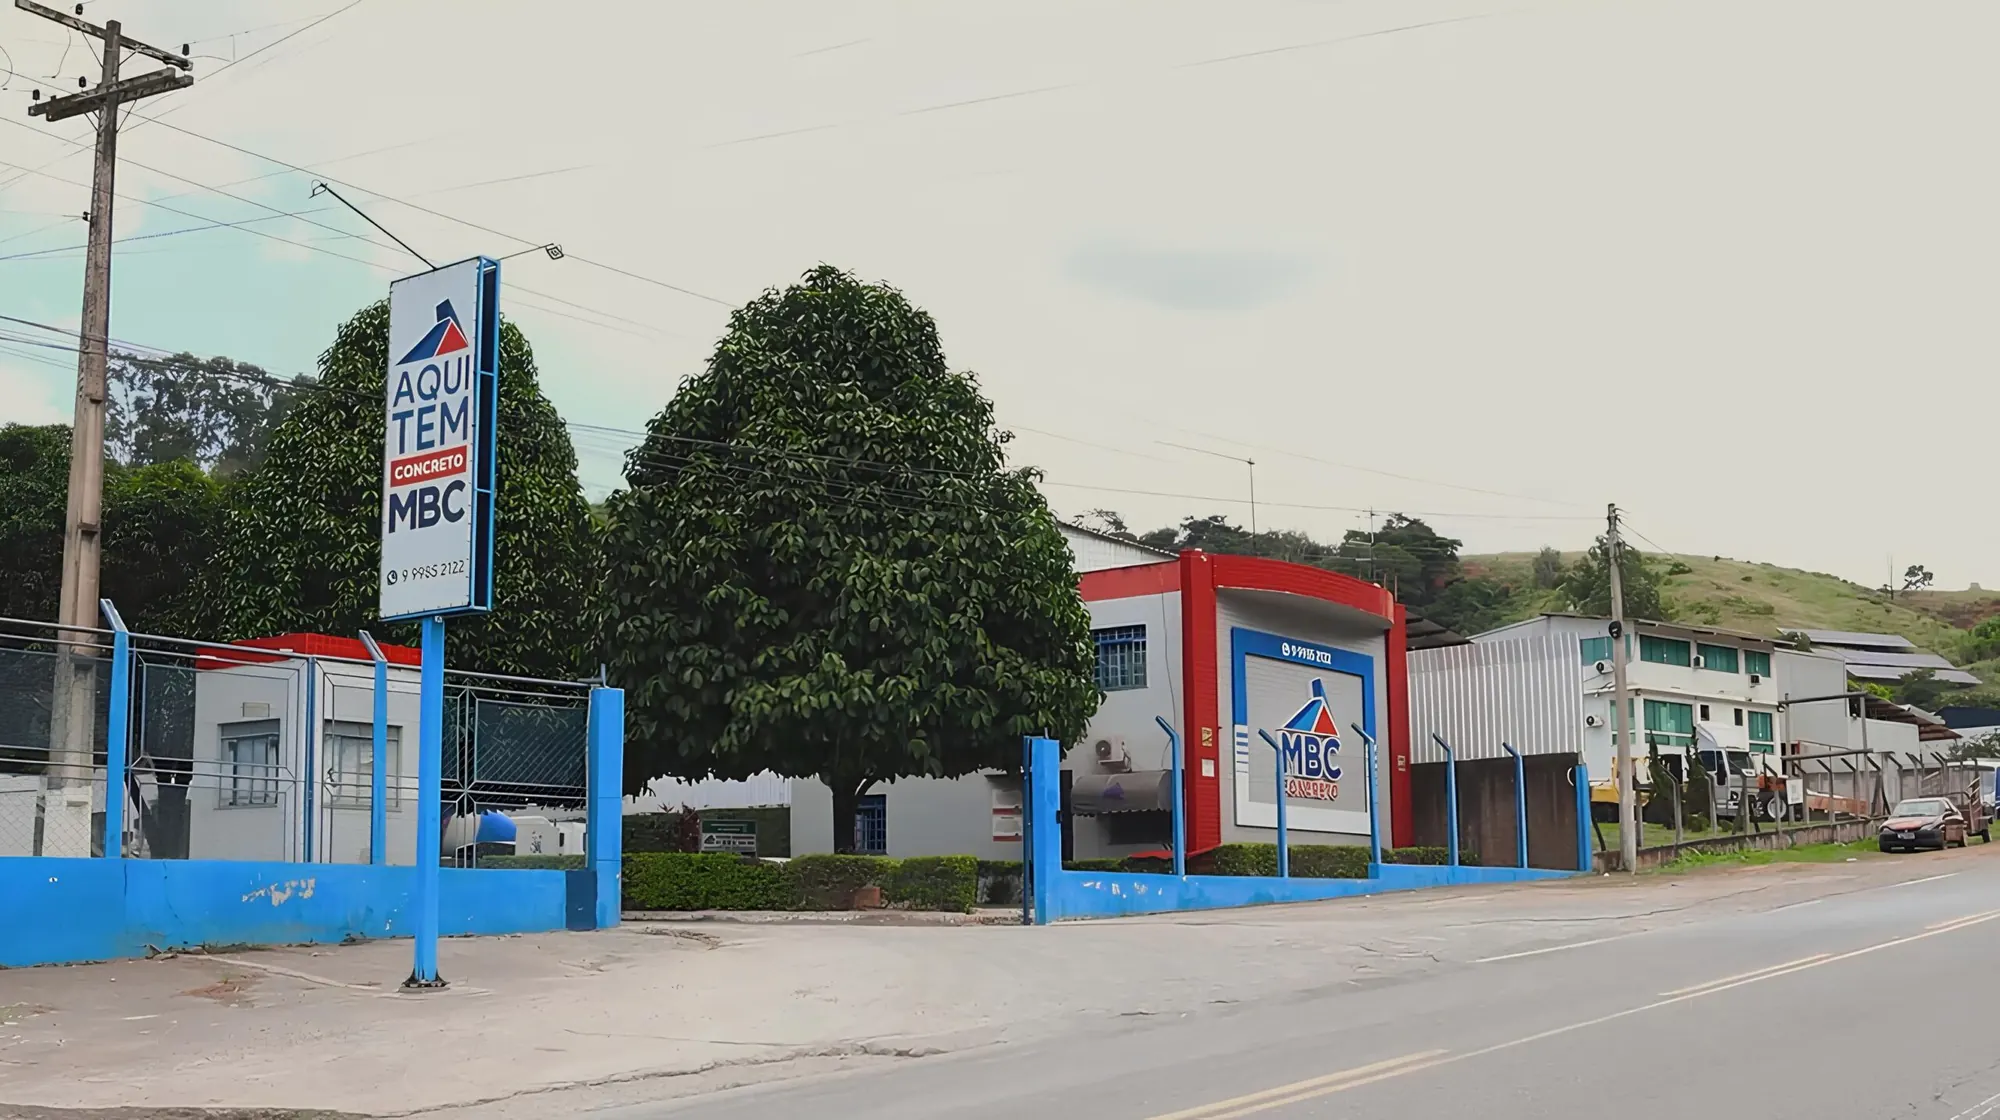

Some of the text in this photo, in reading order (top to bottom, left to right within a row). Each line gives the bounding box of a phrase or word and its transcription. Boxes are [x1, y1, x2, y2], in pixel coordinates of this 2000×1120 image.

[393, 354, 470, 408] AQUI
[392, 395, 469, 455] TEM
[394, 453, 464, 480] CONCRETO
[389, 479, 467, 534] MBC
[402, 569, 409, 583] 9
[440, 560, 465, 576] 2122
[1280, 732, 1342, 780] MBC
